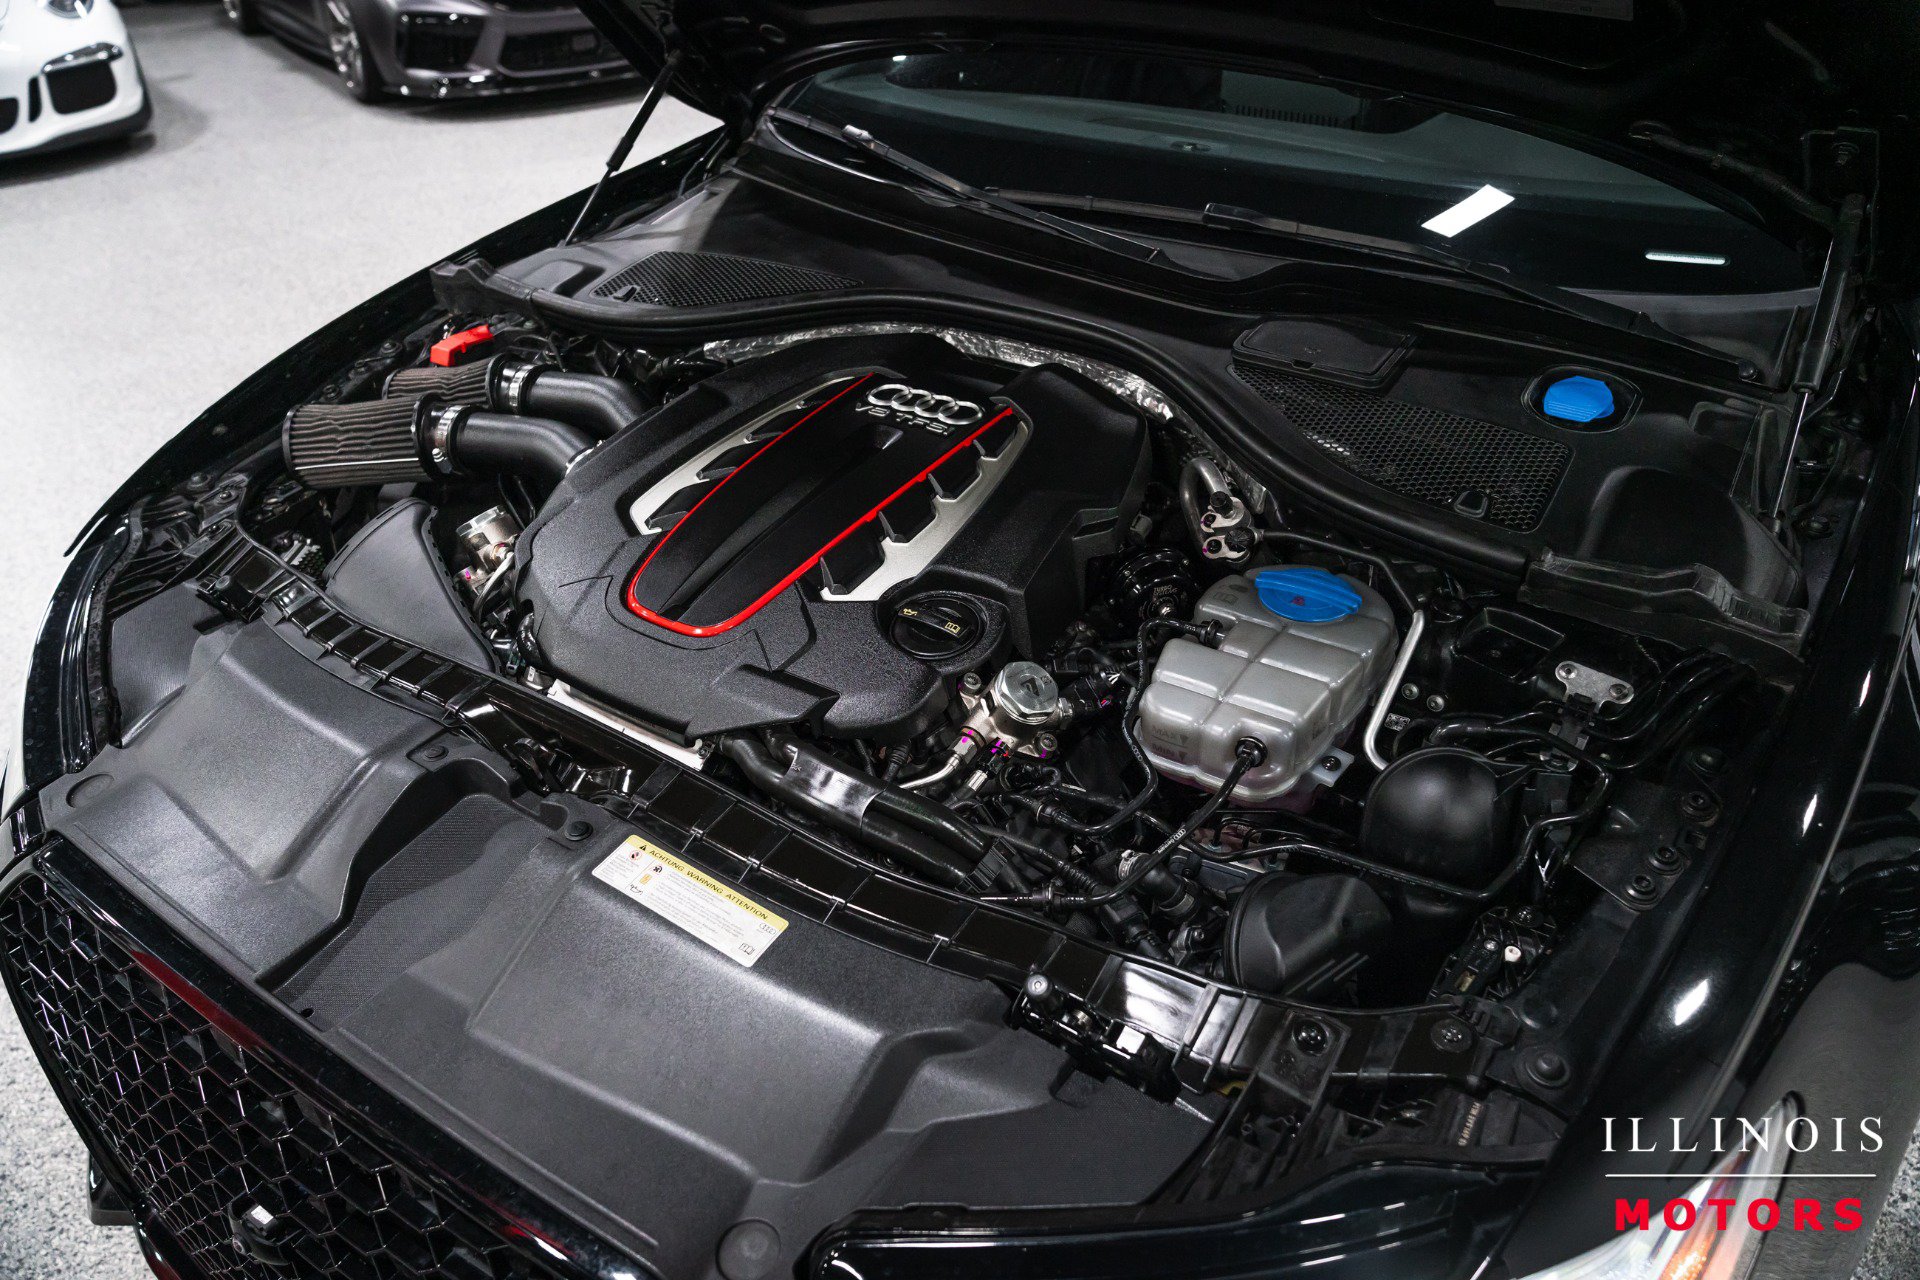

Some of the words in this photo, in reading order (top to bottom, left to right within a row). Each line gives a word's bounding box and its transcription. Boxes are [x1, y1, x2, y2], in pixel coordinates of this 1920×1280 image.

[855, 402, 890, 417] V8
[896, 412, 956, 435] TFSI
[1152, 725, 1175, 739] MAX
[1152, 743, 1175, 757] MIN
[649, 849, 685, 873] ACHTUNG
[686, 871, 724, 895] WARNING
[725, 893, 769, 920] ATTENTION
